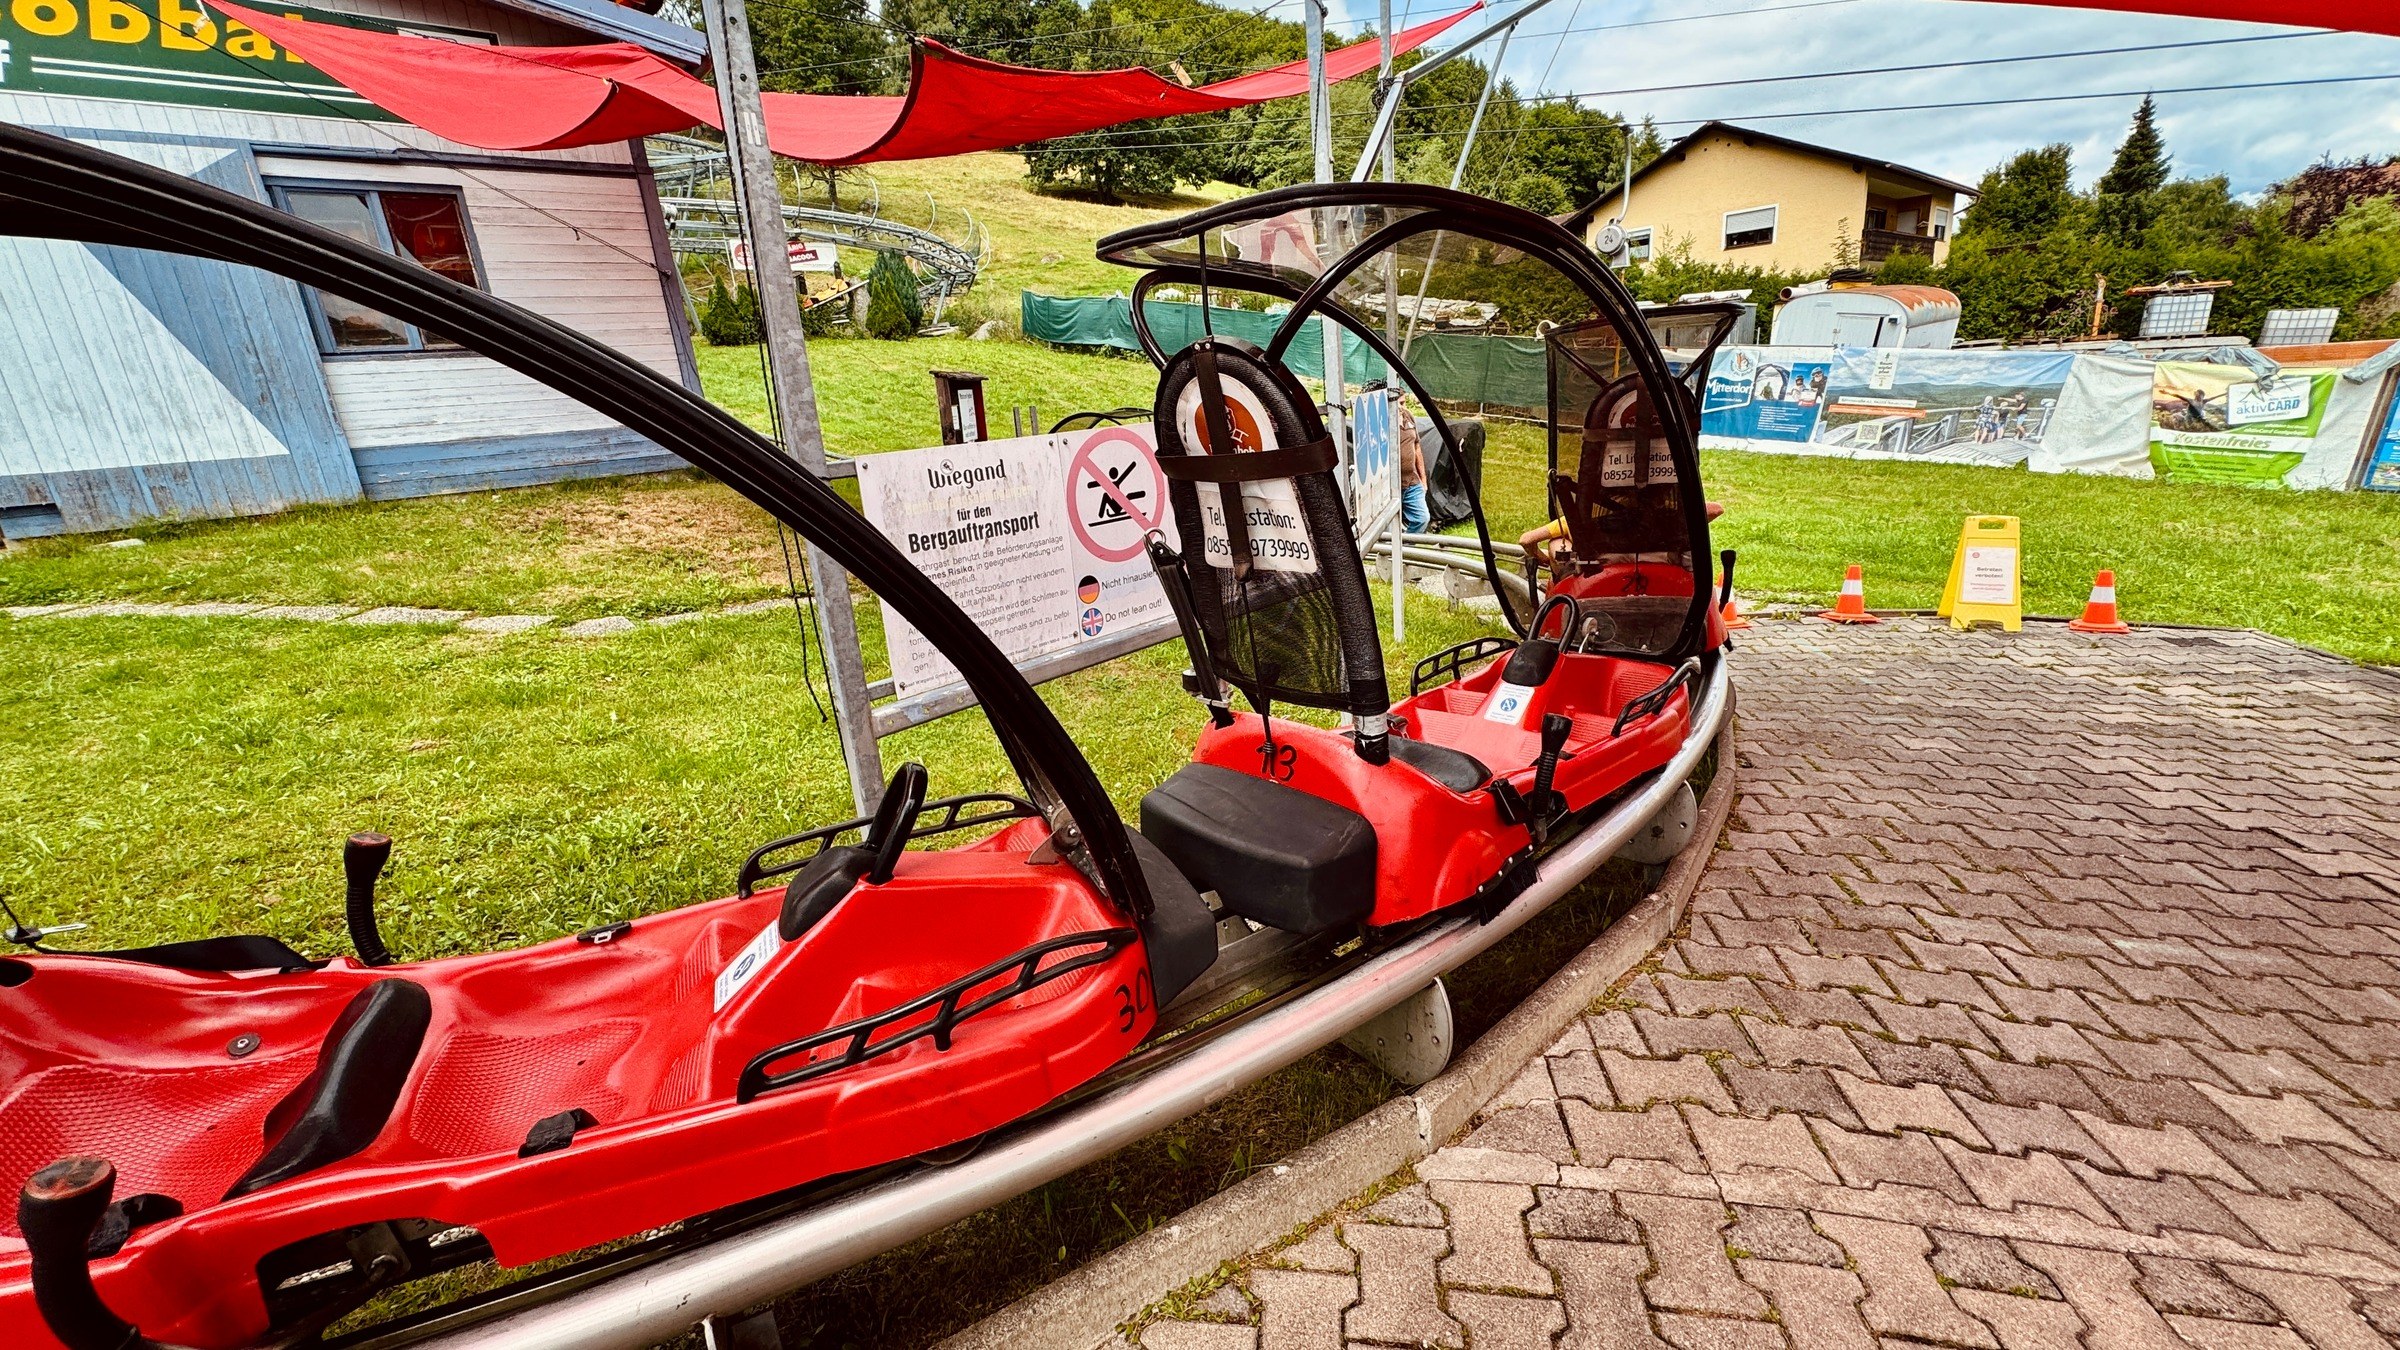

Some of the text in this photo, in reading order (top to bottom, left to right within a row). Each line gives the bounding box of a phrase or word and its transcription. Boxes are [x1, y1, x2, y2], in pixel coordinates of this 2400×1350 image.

[1706, 379, 1754, 395] Mitterdorf
[2236, 399, 2301, 414] aktivCARD
[2175, 433, 2272, 449] Kostenfreies
[1609, 454, 1624, 465] Tel.
[927, 458, 1007, 489] Wiegand
[957, 506, 992, 522] für den
[1206, 506, 1225, 527] Tel.
[908, 511, 1040, 553] Bergauftransport
[952, 553, 981, 566] benutzt
[983, 550, 994, 559] die
[976, 563, 983, 571] in
[1052, 544, 1065, 554] und
[954, 588, 974, 600] Fahrt
[975, 579, 1015, 594] Sitzposition
[1016, 574, 1032, 585] nicht
[1101, 577, 1121, 590] Nicht
[1005, 600, 1020, 611] wird
[1020, 598, 1031, 607] der
[1105, 598, 1162, 622] Do not lean out!
[994, 623, 1028, 637] Personals
[1029, 618, 1043, 628] sind
[1044, 615, 1053, 623] zu
[911, 652, 926, 661] Die
[1113, 966, 1150, 1034] 30
